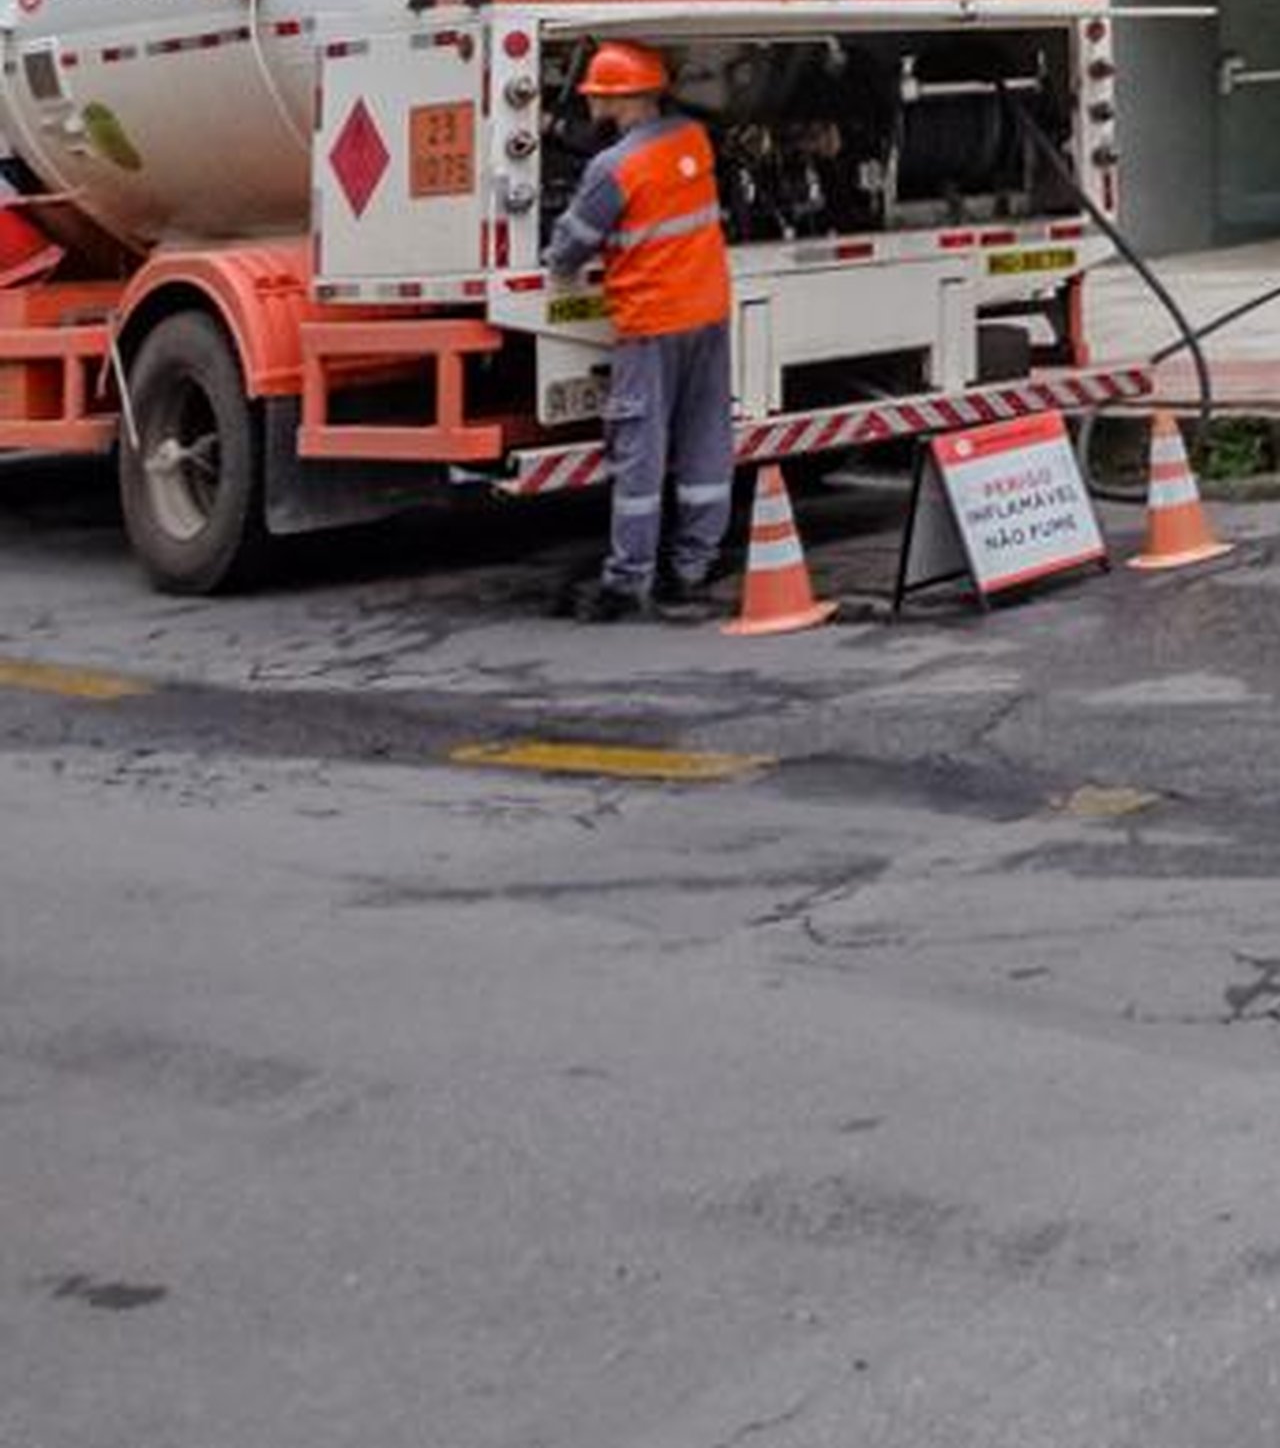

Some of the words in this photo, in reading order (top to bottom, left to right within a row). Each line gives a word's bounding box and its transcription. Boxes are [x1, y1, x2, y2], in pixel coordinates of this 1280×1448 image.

[983, 466, 1052, 498] PERIGO
[984, 523, 1026, 552] NÃO
[1029, 513, 1078, 540] FUME
